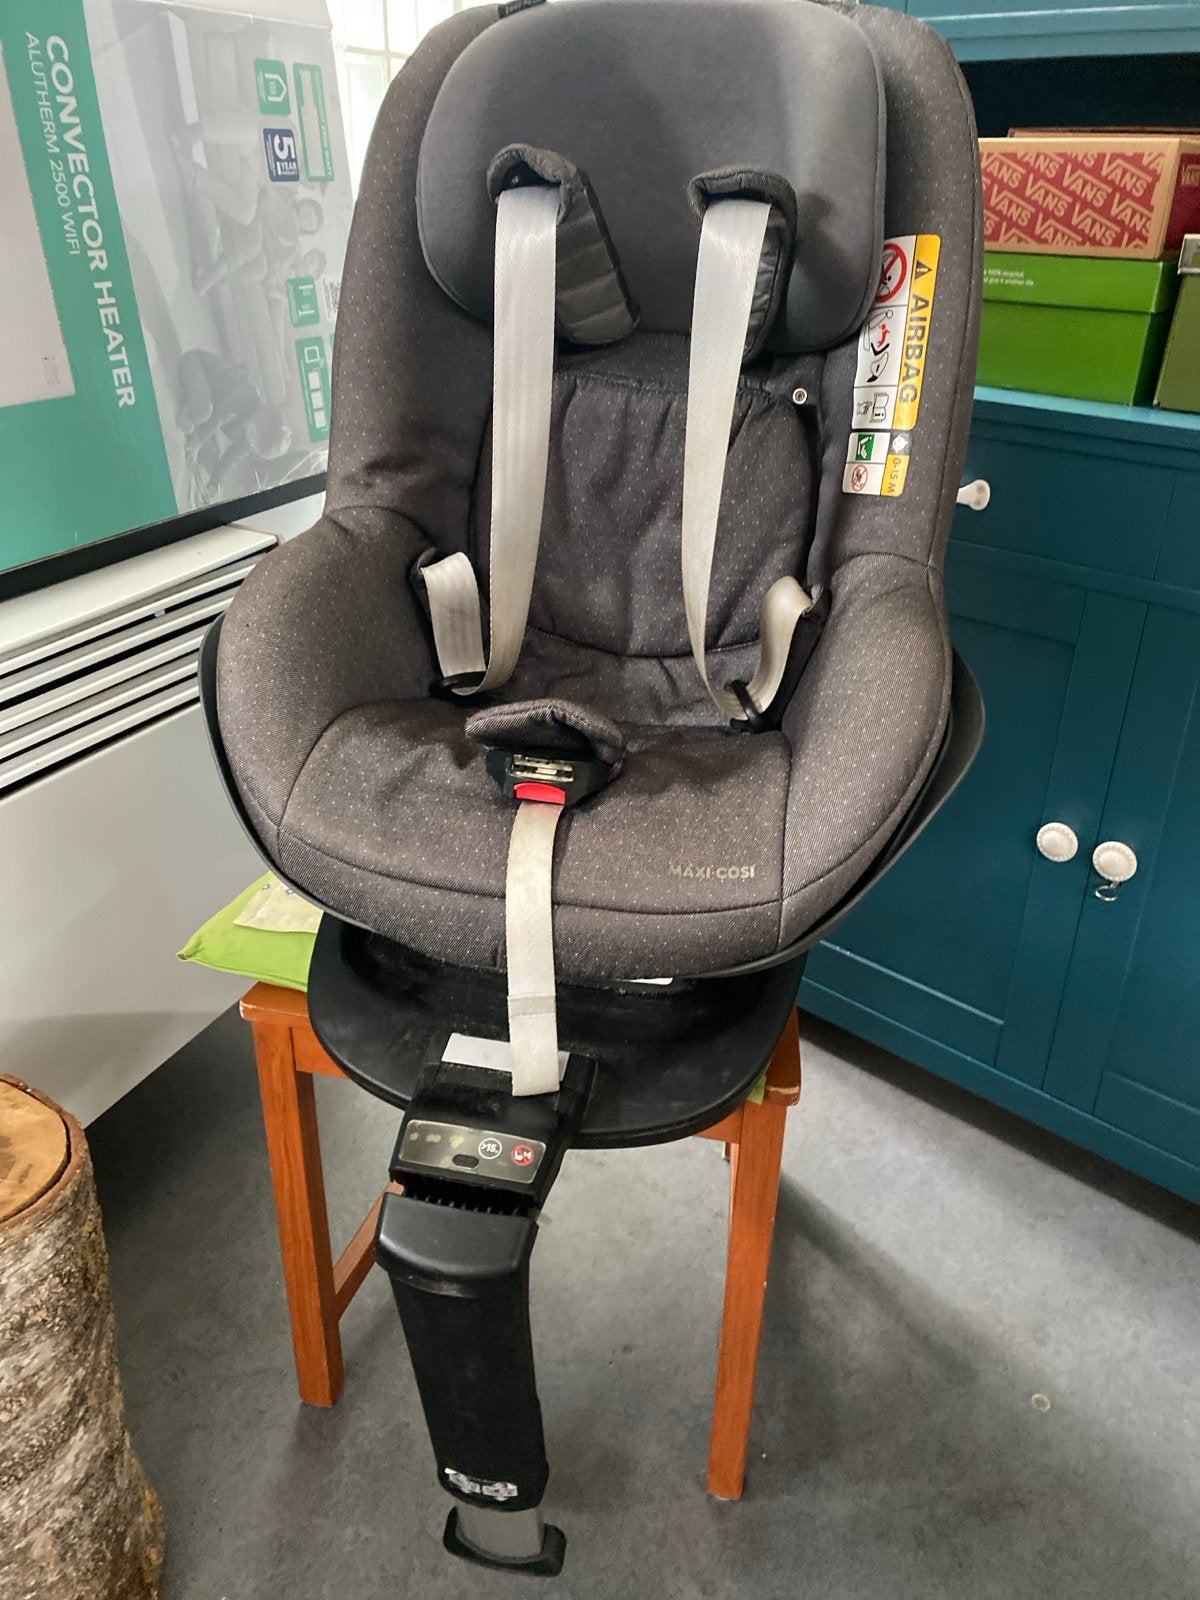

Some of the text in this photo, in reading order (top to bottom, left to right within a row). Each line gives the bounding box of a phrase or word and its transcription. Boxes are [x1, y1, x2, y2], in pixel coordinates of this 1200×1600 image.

[25, 31, 81, 256] ALUTHERM 2500 WIFI
[274, 134, 296, 160] 5
[280, 162, 297, 170] YEAR
[1024, 173, 1073, 217] VANS
[1062, 162, 1112, 208] VANS
[1101, 152, 1153, 198] VANS
[46, 35, 135, 407] CONVECTOR HEATER
[990, 183, 1035, 227] VANS
[1071, 202, 1121, 247] VANS
[898, 294, 930, 403] AIRBAG
